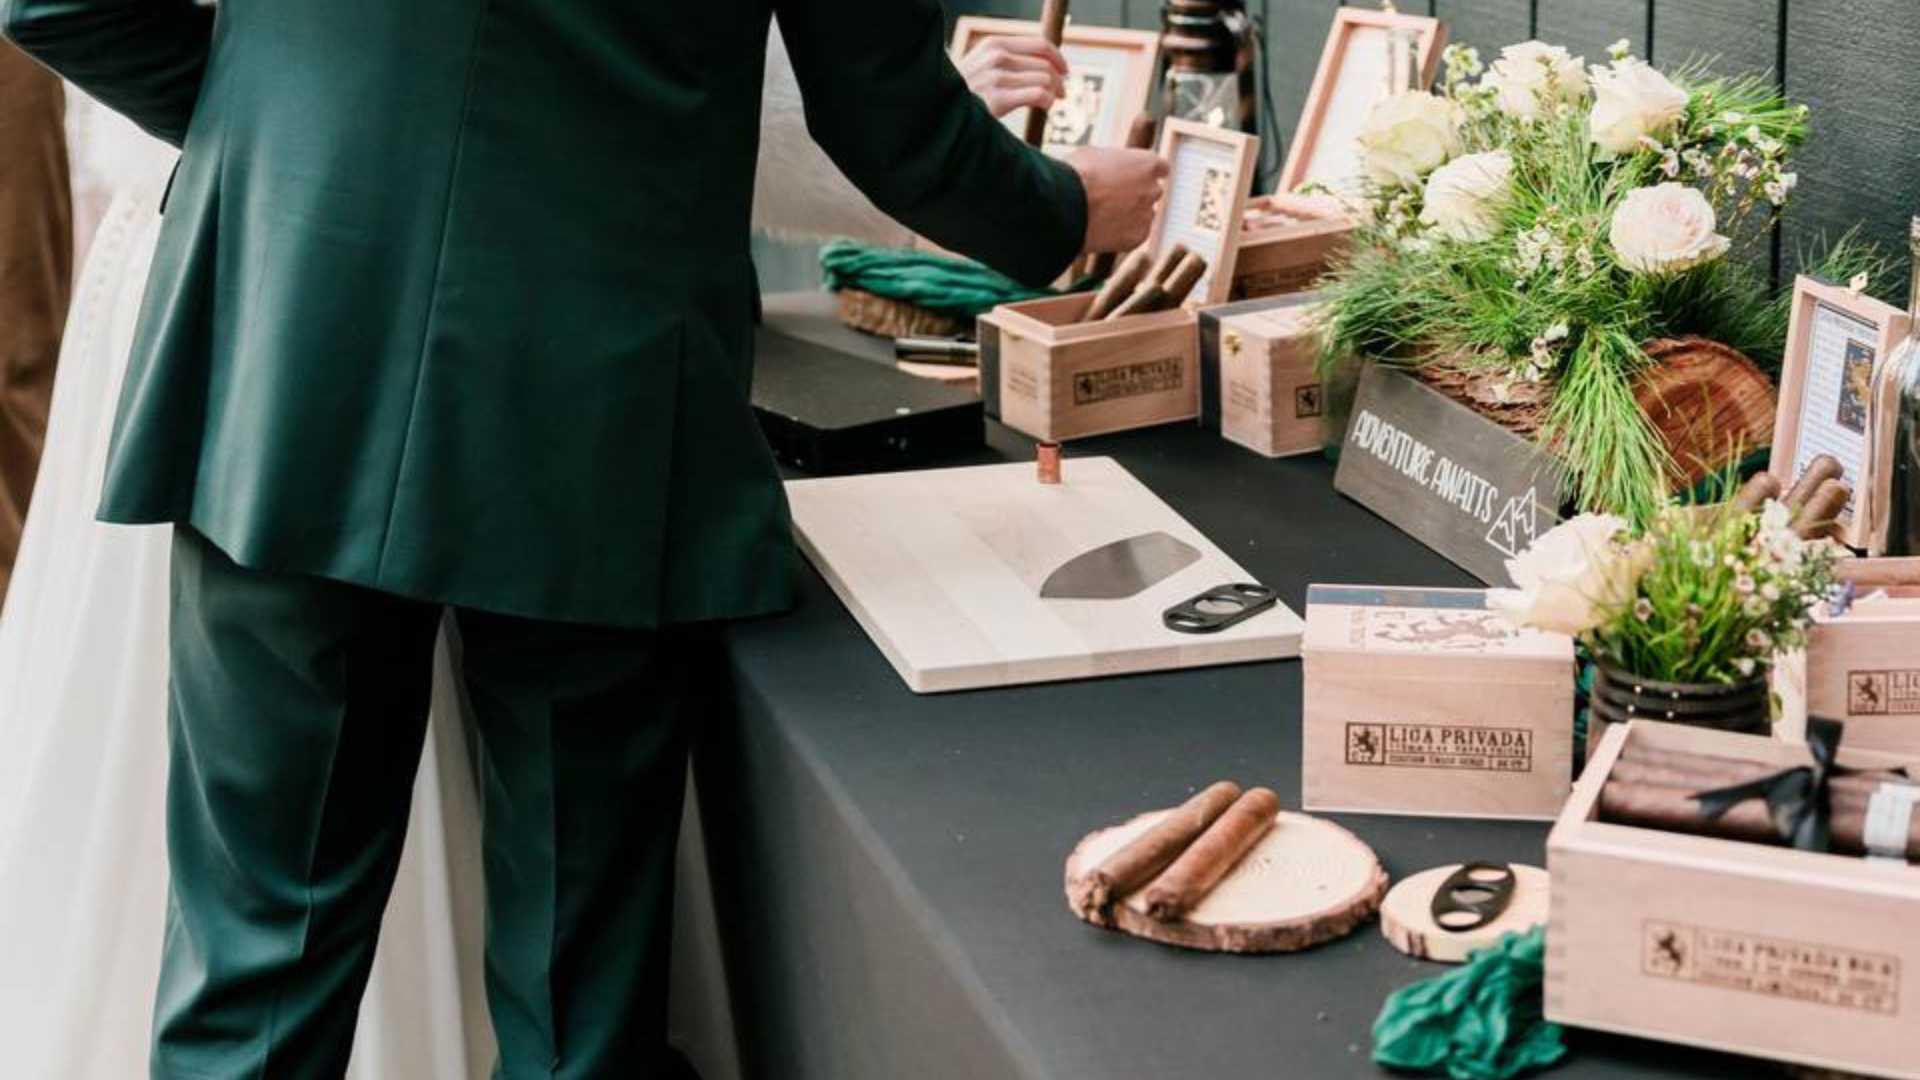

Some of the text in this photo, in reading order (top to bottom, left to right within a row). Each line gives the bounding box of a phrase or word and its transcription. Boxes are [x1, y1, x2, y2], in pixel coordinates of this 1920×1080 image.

[1351, 409, 1498, 523] ADVENTURE AWAITS
[1389, 727, 1526, 748] LIGA PRIVADA
